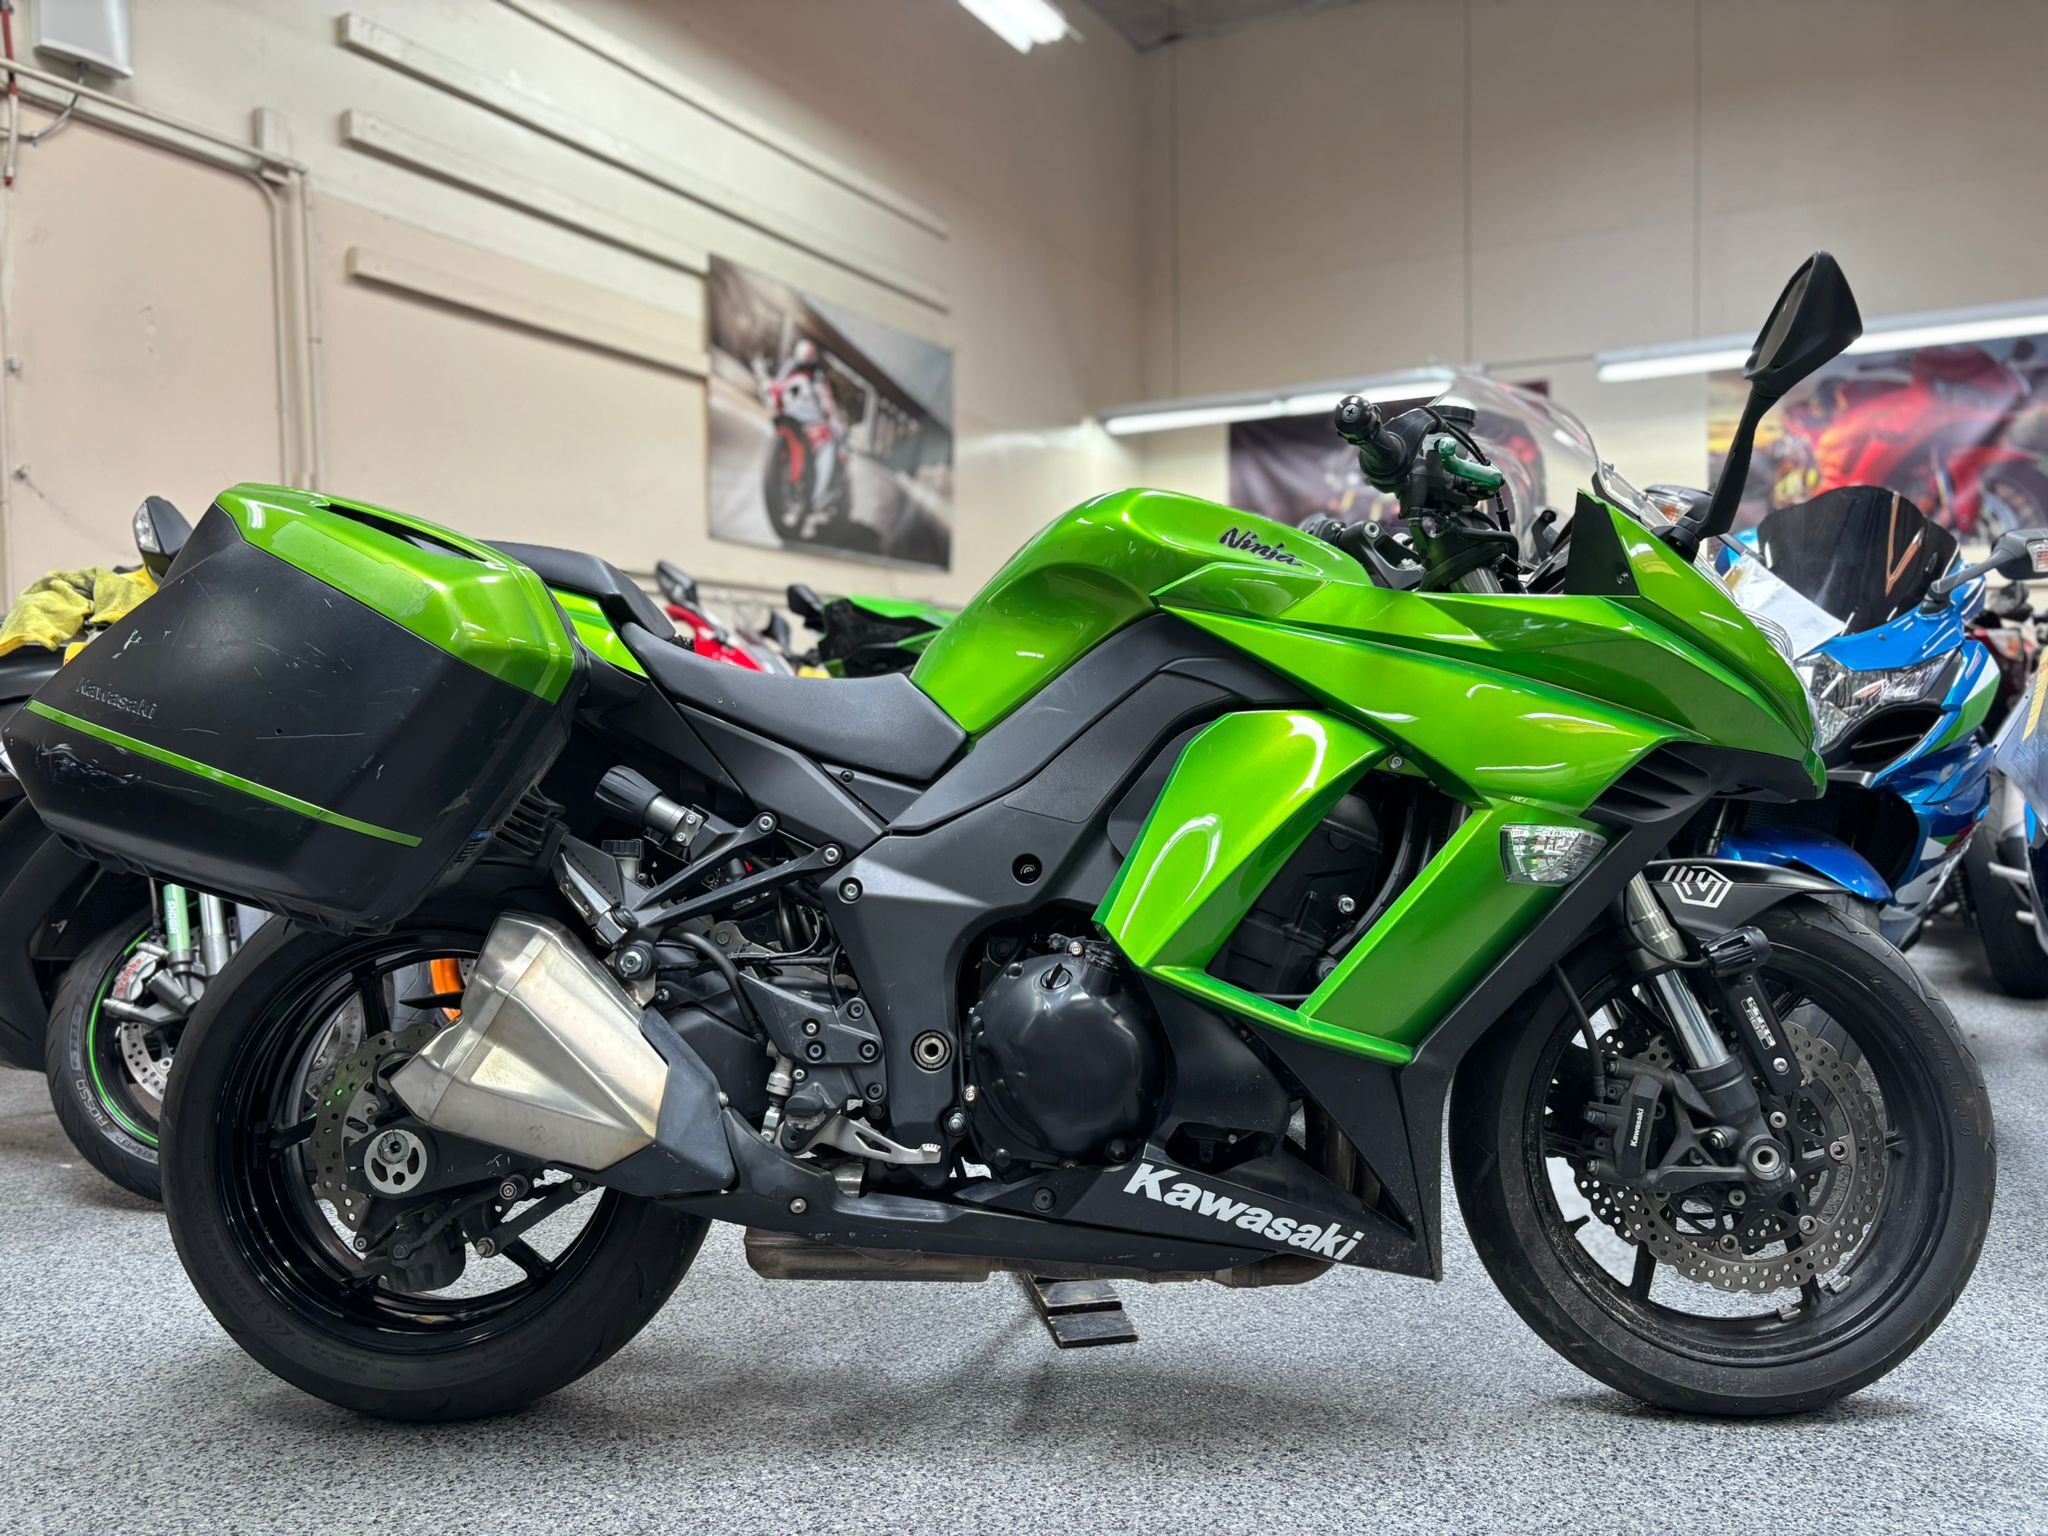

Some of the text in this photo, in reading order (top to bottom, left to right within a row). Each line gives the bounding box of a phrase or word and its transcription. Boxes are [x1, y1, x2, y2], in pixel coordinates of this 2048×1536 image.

[1219, 527, 1303, 567] Ninja
[76, 677, 157, 719] Kawasaki
[167, 900, 178, 935] SHOWA
[76, 1079, 108, 1127] ROSSO
[1630, 1107, 1644, 1147] Kawasaki
[1123, 1162, 1365, 1261] Kawasaki
